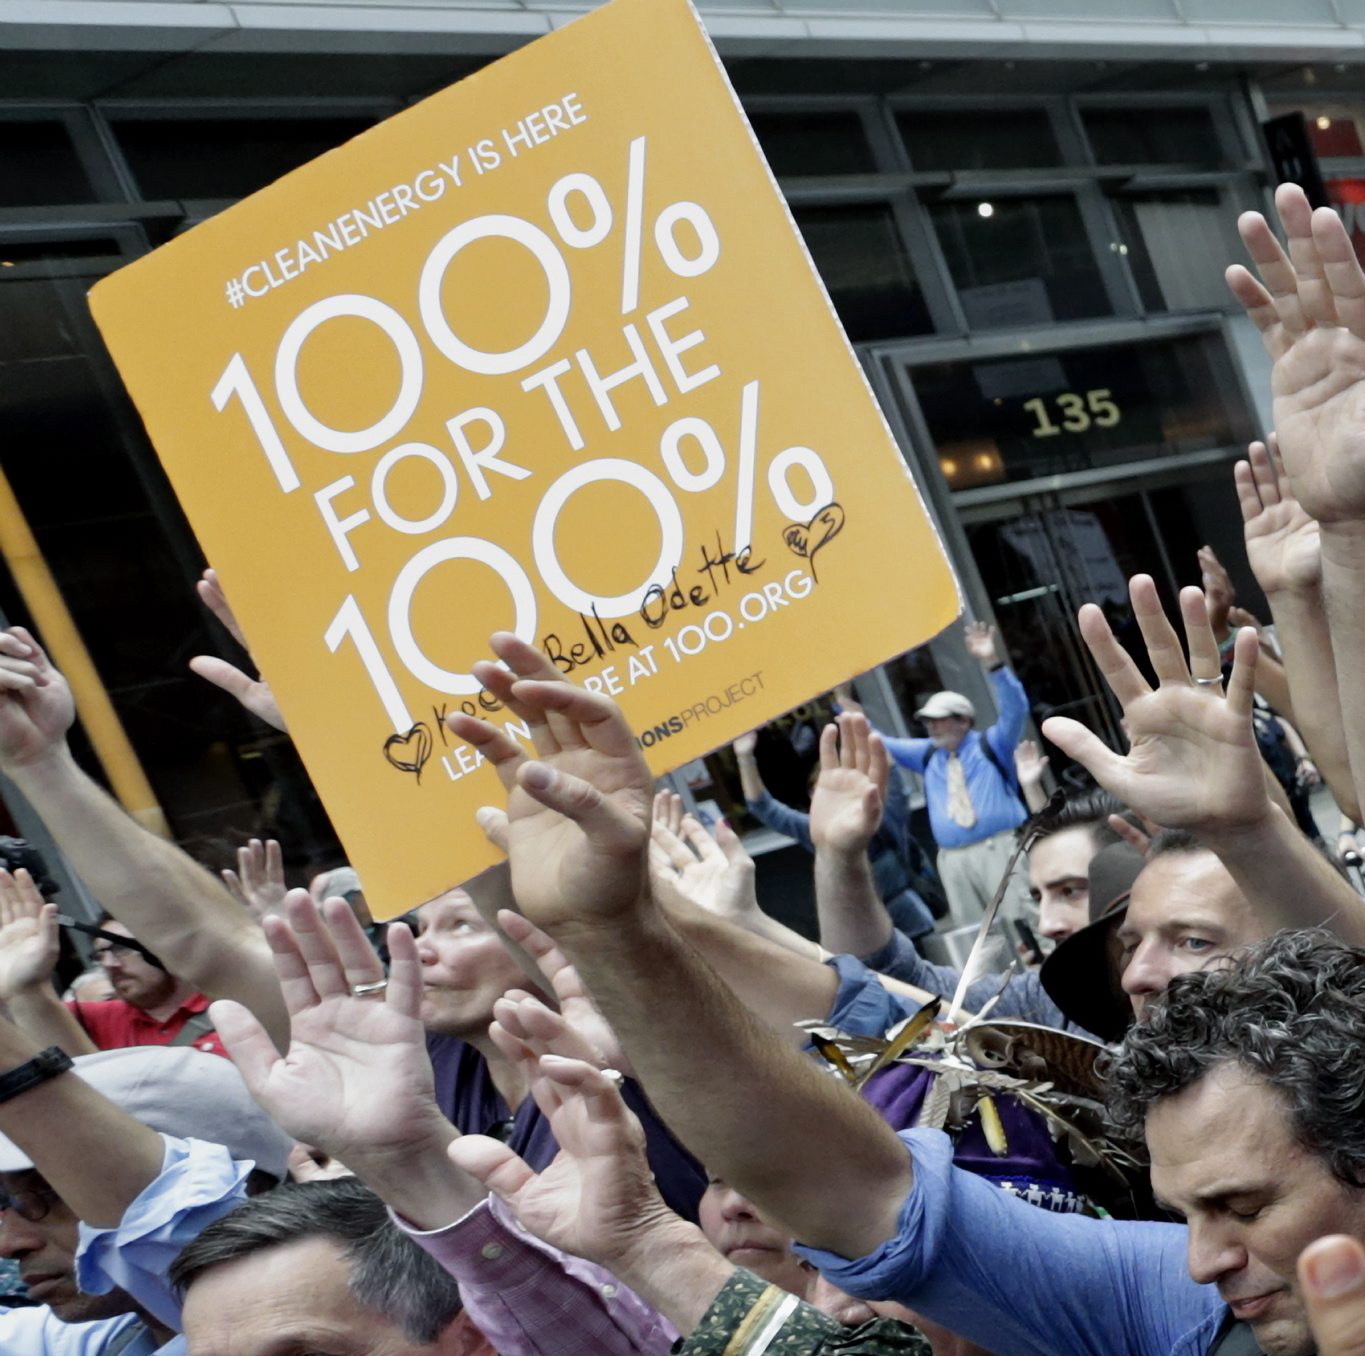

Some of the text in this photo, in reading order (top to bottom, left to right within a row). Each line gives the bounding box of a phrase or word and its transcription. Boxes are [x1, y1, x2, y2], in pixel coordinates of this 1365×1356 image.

[225, 92, 588, 309] #CLEANENERGY IS HERE
[210, 136, 721, 494] 100%
[1024, 389, 1120, 437] 135
[313, 296, 721, 572] FOR THE
[323, 380, 835, 738] 100%
[542, 601, 638, 674] Bella
[639, 529, 767, 629] Odette
[440, 721, 532, 782] LEN
[617, 645, 660, 687] AT
[663, 569, 814, 664] 100.ORG
